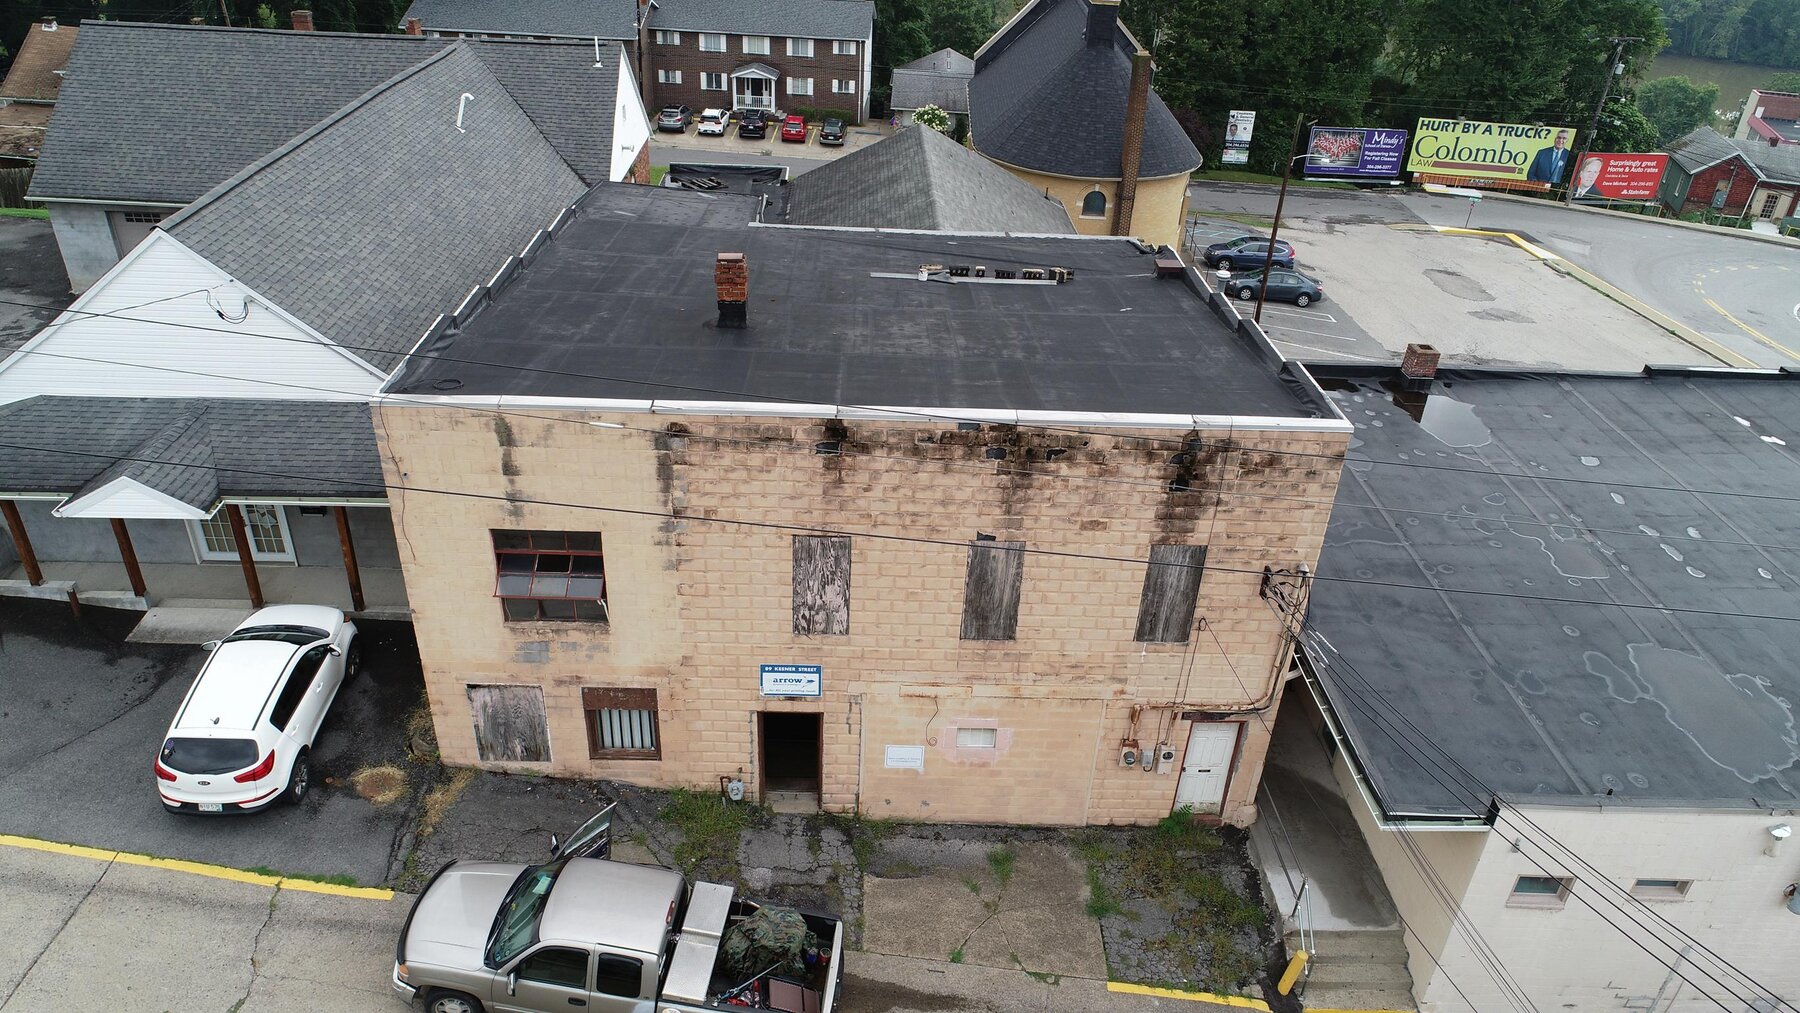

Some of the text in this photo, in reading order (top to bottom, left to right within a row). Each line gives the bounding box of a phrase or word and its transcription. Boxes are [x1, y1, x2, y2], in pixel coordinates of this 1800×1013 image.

[1420, 120, 1552, 140] HURT BY A TRUCK?
[1372, 131, 1404, 148] Mindy's
[1415, 135, 1528, 166] Colombo
[1410, 159, 1432, 167] LAW
